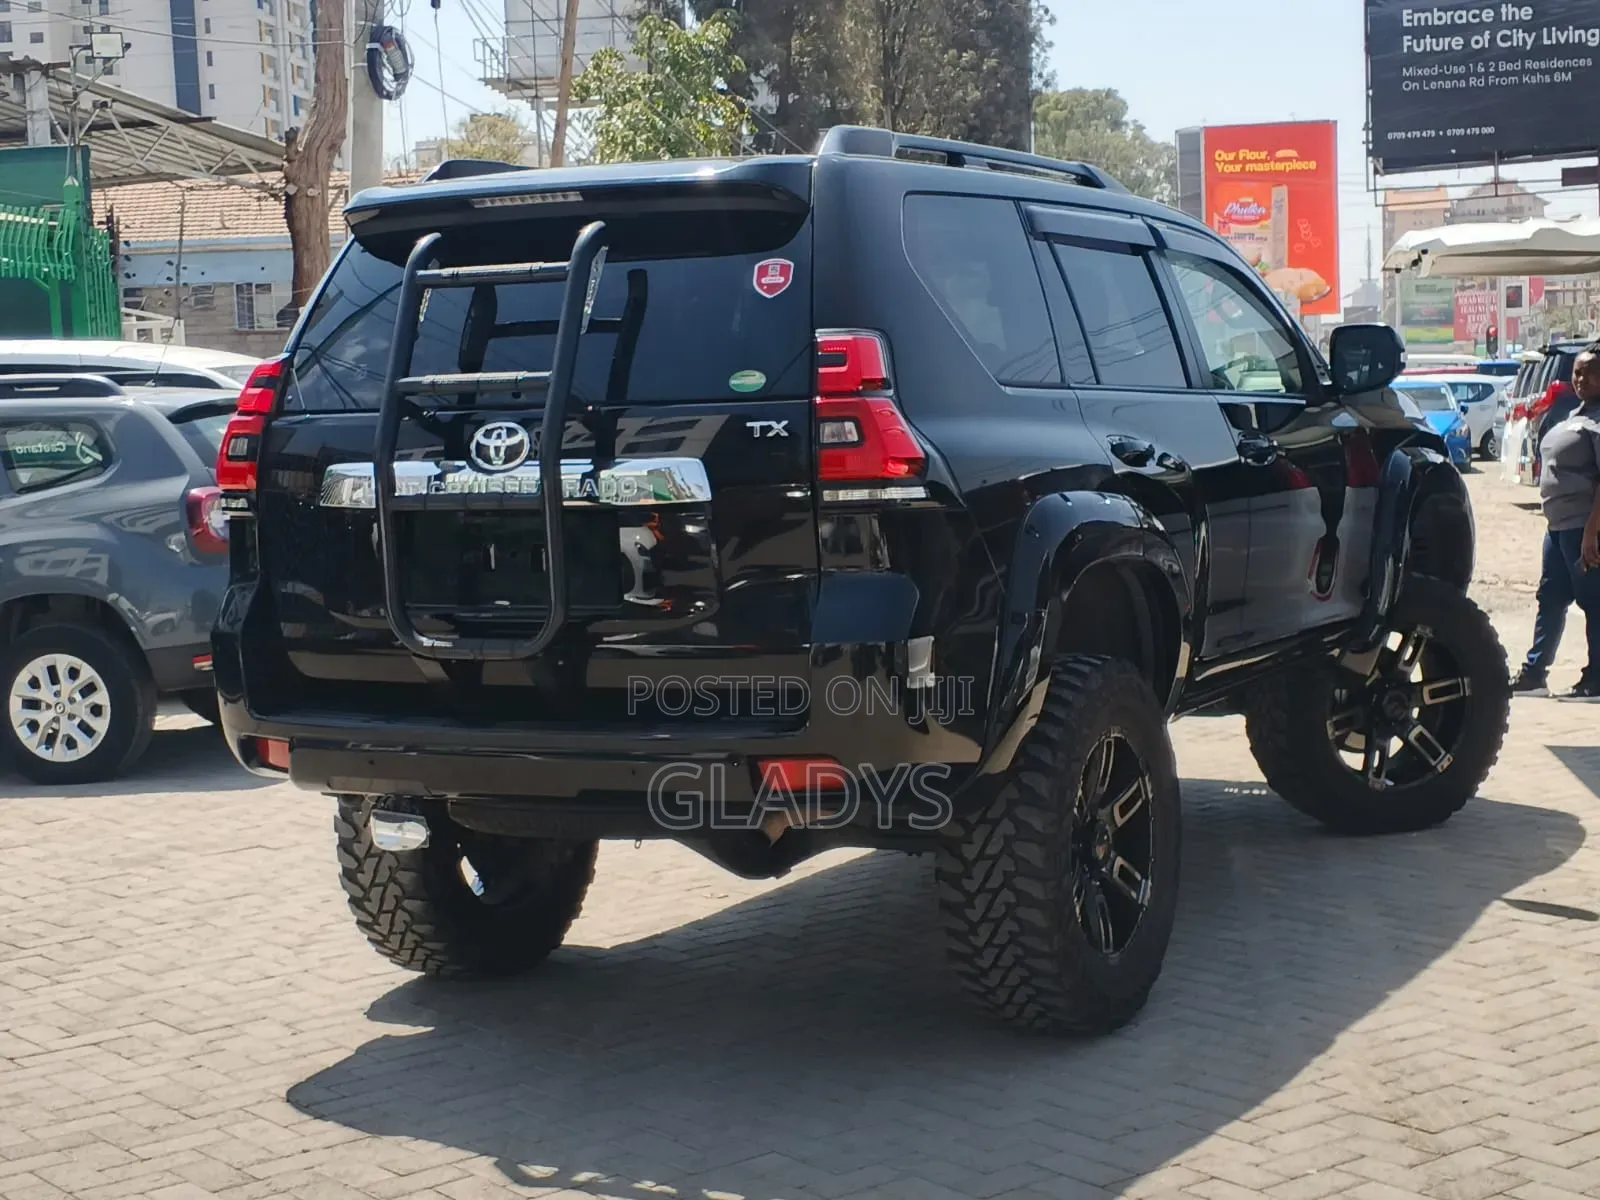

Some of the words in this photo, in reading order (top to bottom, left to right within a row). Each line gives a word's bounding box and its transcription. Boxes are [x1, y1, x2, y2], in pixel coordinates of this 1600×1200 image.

[1402, 8, 1494, 27] Embrace
[1501, 4, 1533, 21] the
[1402, 35, 1464, 53] Future
[1470, 31, 1491, 49] of
[1496, 29, 1536, 50] City
[1543, 26, 1600, 49] Living
[1402, 64, 1466, 77] Mixed-Use
[1469, 63, 1474, 73] 1
[1477, 62, 1485, 73] &
[1489, 62, 1496, 72] 2
[1499, 60, 1521, 71] Bed
[1525, 57, 1593, 70] Residences
[1402, 80, 1420, 91] On
[1423, 78, 1466, 90] Lenana
[1469, 76, 1485, 87] Rd
[1488, 74, 1519, 86] From
[1522, 72, 1551, 84] Kshs
[1554, 71, 1572, 82] 6M
[1215, 150, 1236, 161] Our
[1239, 149, 1270, 160] Flour.
[1215, 162, 1242, 173] Your
[1245, 159, 1316, 172] masterpiece
[746, 420, 789, 438] TX
